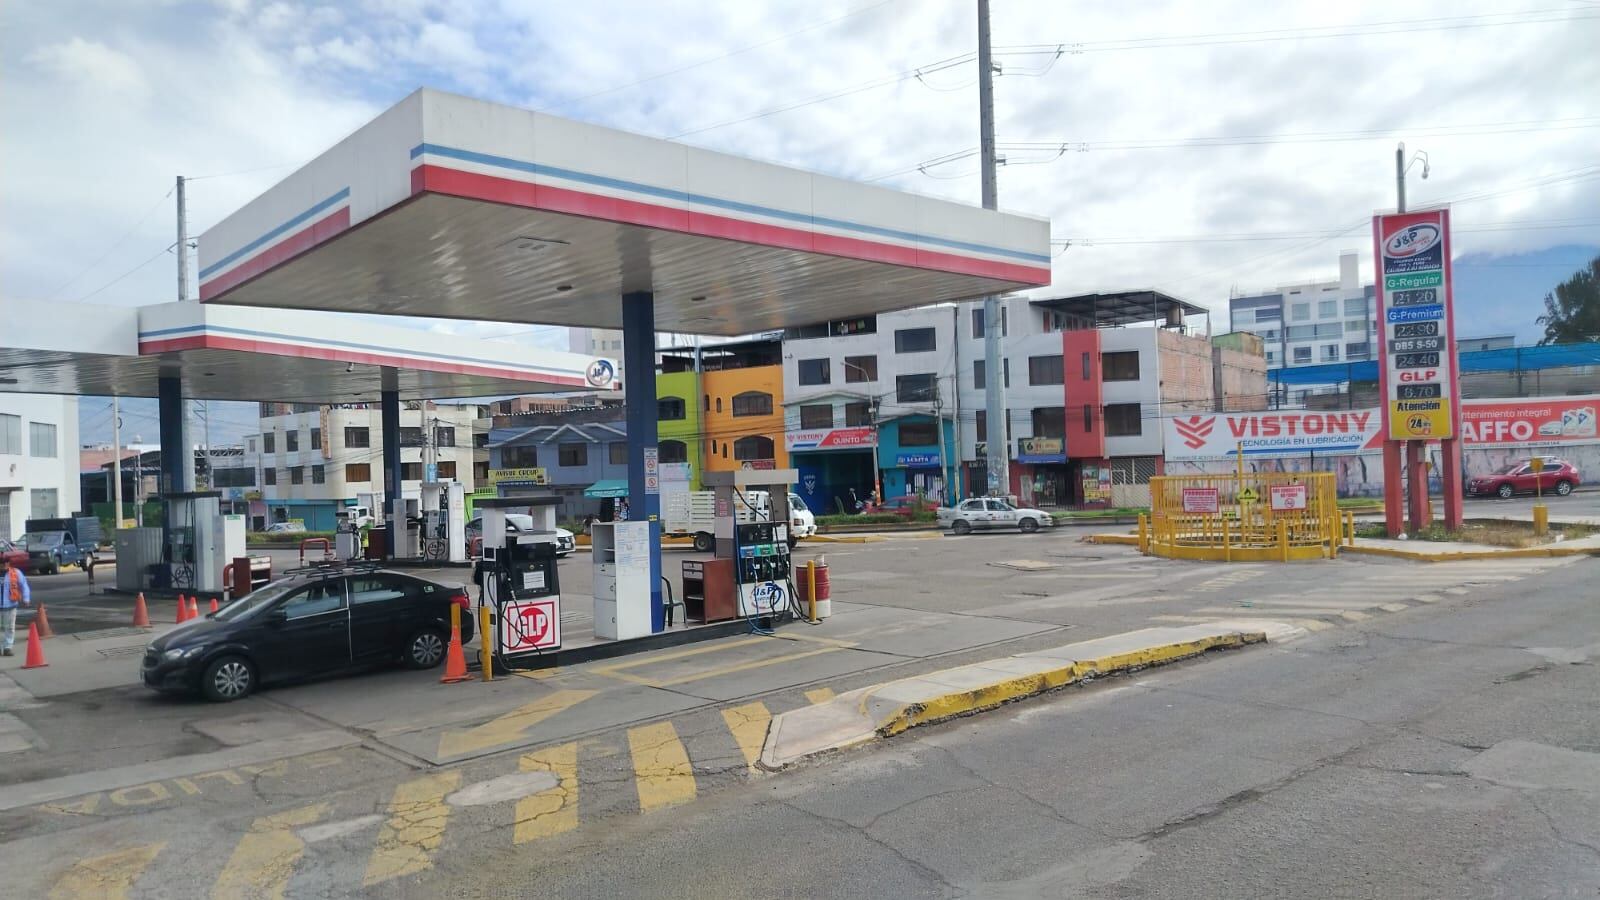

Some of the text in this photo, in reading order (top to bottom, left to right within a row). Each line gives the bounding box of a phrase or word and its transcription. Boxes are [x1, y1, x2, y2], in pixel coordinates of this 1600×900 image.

[1394, 231, 1418, 249] J&P
[1387, 274, 1440, 289] G-Regular
[1389, 308, 1444, 321] G-Premium
[1394, 339, 1438, 351] DB5 S-50
[1399, 370, 1437, 383] GLP
[1397, 400, 1441, 412] Atención
[1462, 410, 1516, 419] ntenimiento
[1227, 411, 1370, 438] VISTONY
[1410, 418, 1422, 429] 24
[832, 437, 860, 445] QUINTO
[1307, 434, 1364, 445] LUBRICACIÓN
[518, 613, 547, 637] GLP
